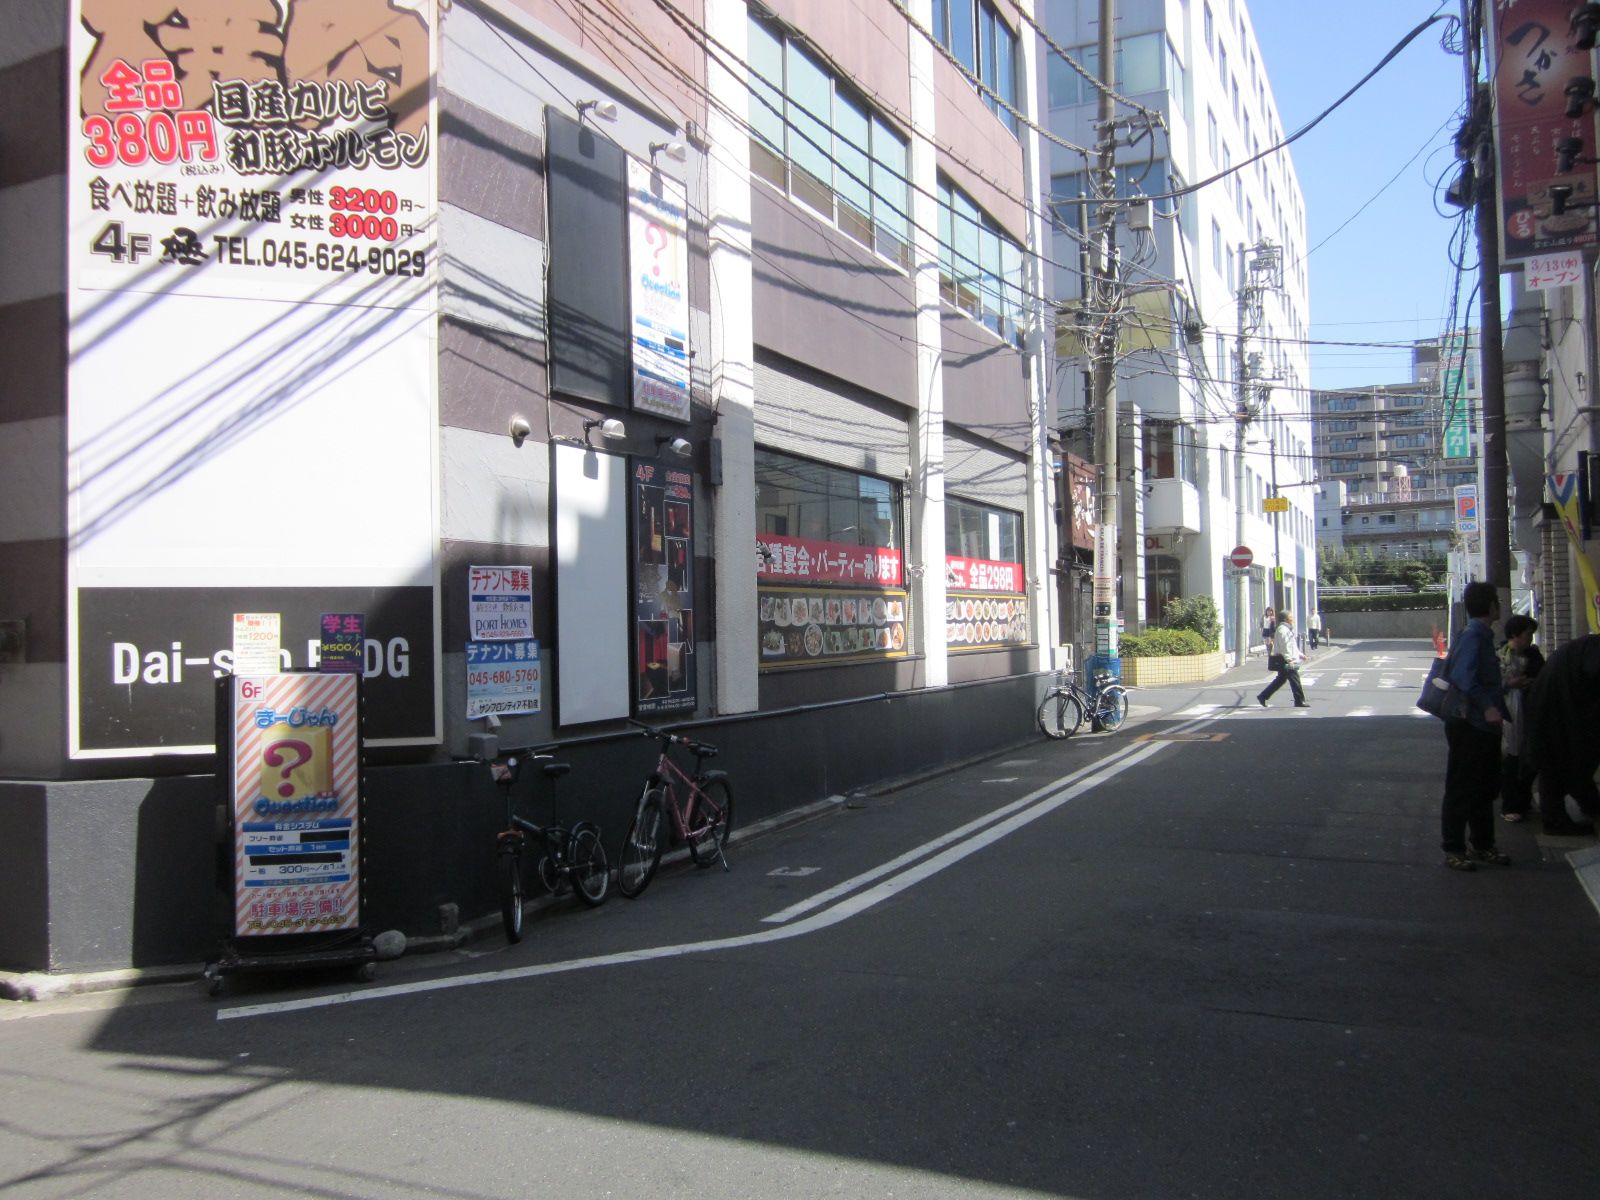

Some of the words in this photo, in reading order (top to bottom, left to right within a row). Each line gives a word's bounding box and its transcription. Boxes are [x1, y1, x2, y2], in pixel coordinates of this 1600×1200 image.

[101, 59, 183, 112] 全品
[213, 79, 389, 125] 国産カルビ
[82, 111, 218, 168] 380円
[226, 126, 429, 175] 和豚ホルモン
[91, 220, 151, 265] 4F
[1529, 271, 1580, 289] オープン
[472, 570, 530, 591] テナント募集
[969, 562, 1014, 591] 全品298円
[323, 615, 361, 633] 学生
[114, 641, 292, 685] Dai-sn
[468, 643, 538, 661] テナント募集
[241, 681, 262, 698] 6F
[469, 669, 538, 686] 045-680-5760
[255, 706, 338, 728] まーじゃん
